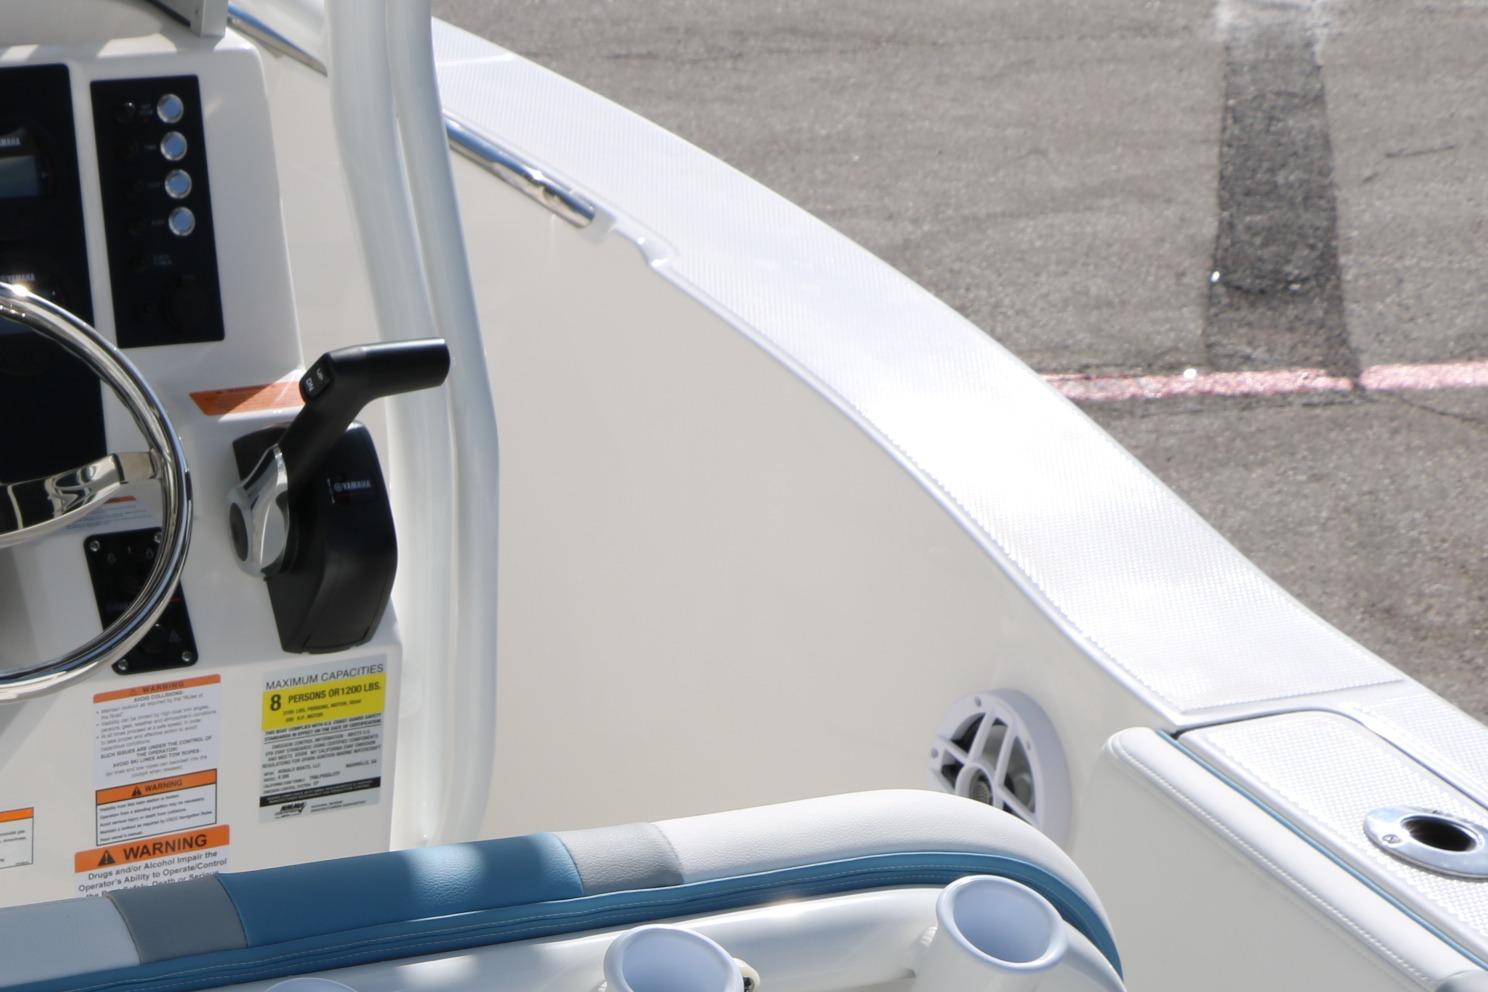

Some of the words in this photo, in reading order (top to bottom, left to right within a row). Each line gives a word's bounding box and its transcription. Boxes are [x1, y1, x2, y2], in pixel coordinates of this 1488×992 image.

[266, 675, 318, 690] MAXIMUM
[321, 664, 384, 681] CAPACITIES
[270, 694, 282, 711] 8
[288, 690, 327, 704] PERSONS
[144, 779, 183, 792] WARNING
[123, 834, 207, 860] WARNING
[78, 878, 122, 893] Operator's
[124, 873, 150, 885] Ability
[152, 870, 161, 879] to
[162, 858, 228, 877] Operate/Control
[88, 870, 112, 881] Drugs
[115, 864, 141, 876] and/or
[144, 857, 175, 869] Alcohol
[177, 853, 203, 866] Impair
[205, 850, 218, 859] the
